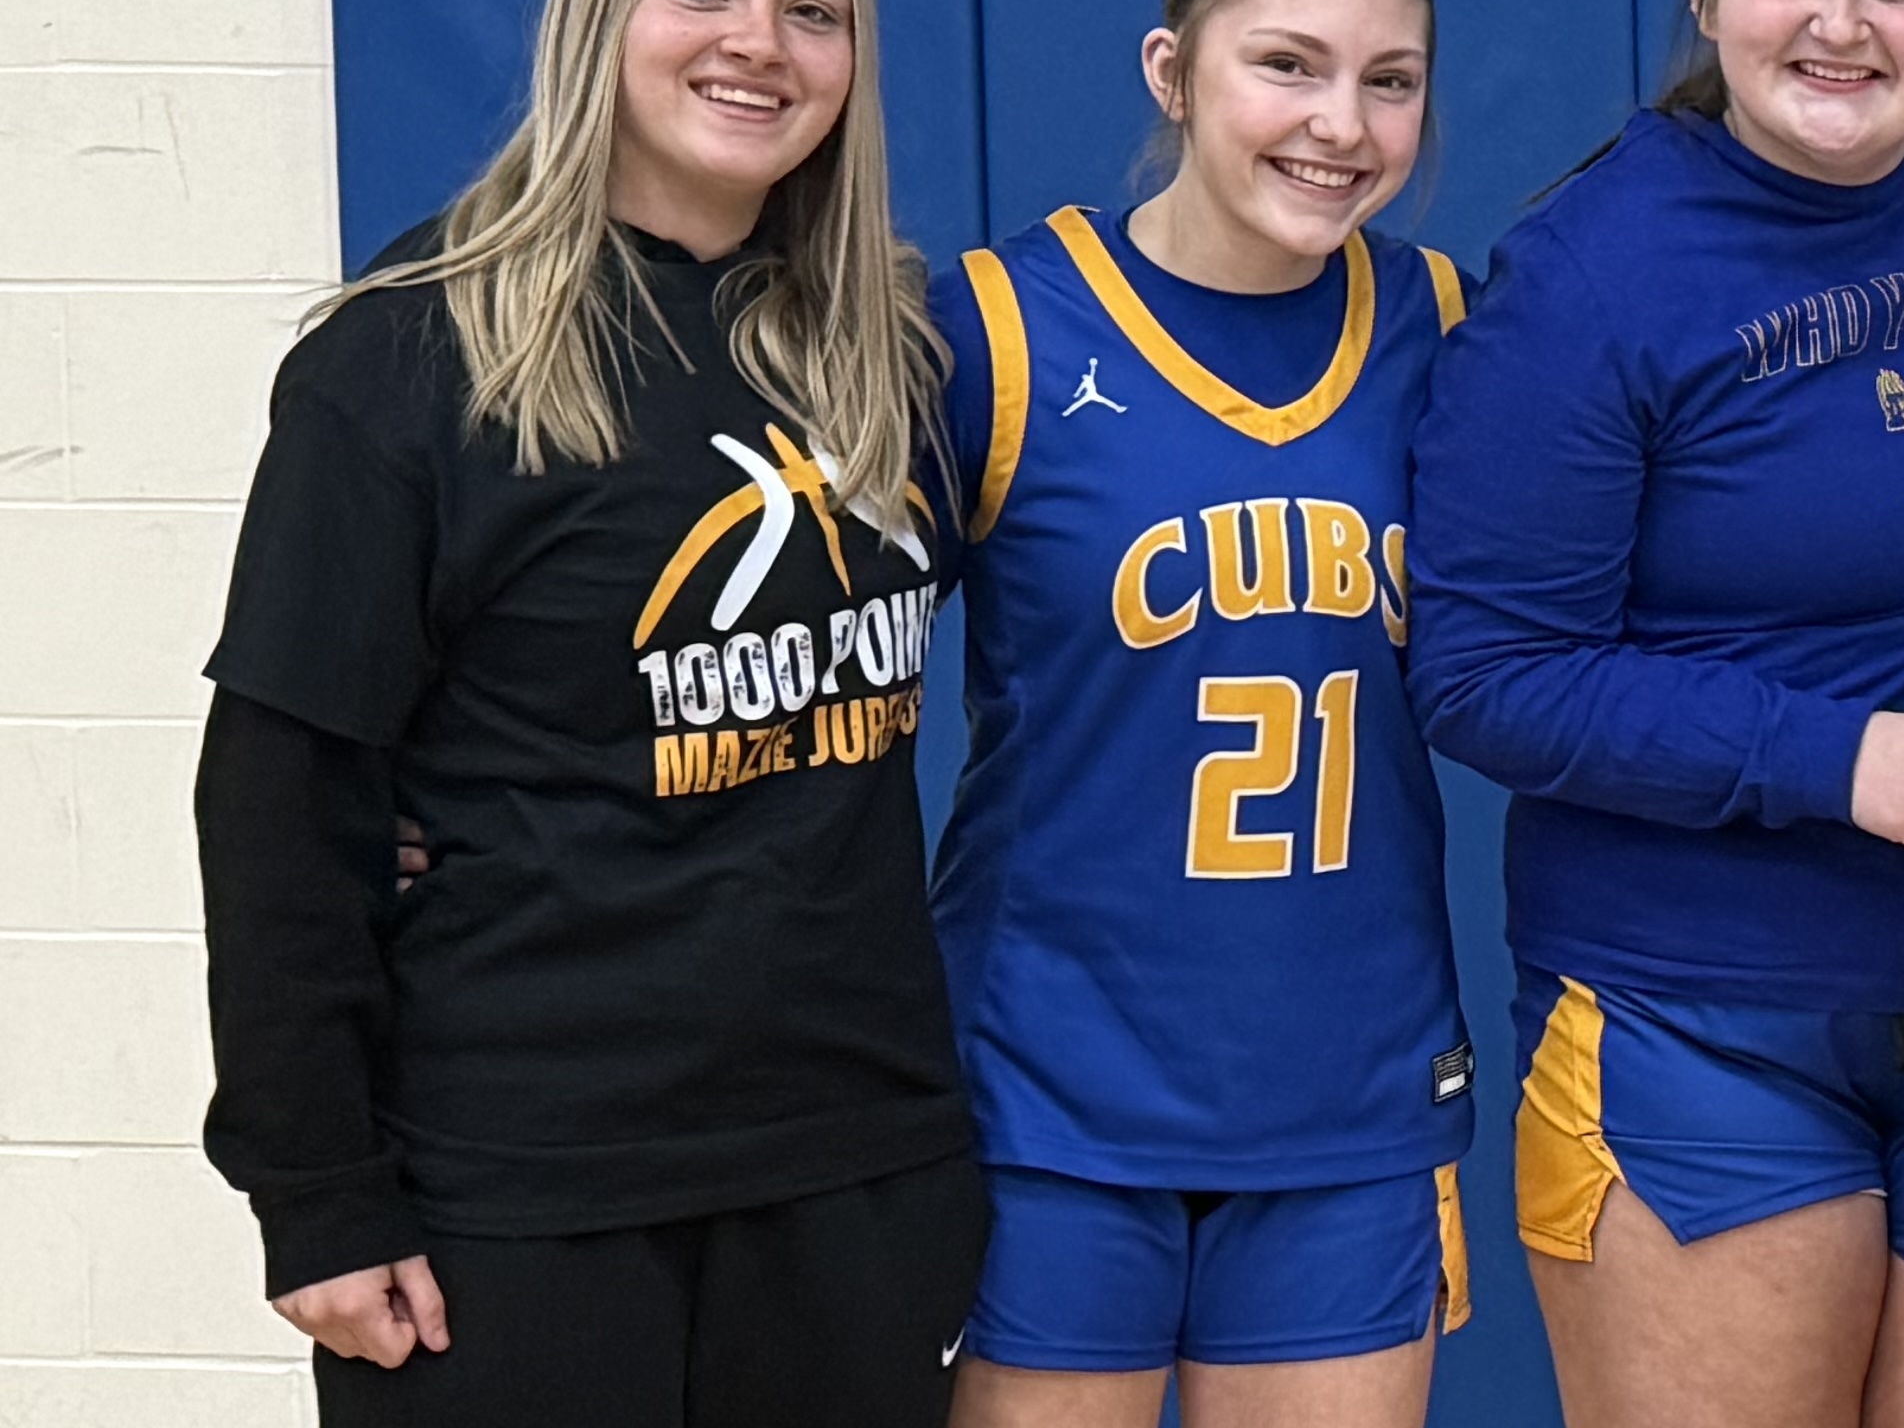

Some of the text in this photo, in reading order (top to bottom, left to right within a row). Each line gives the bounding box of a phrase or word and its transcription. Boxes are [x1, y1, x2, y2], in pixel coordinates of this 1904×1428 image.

[637, 622, 816, 727] 1000
[654, 714, 798, 798] MAZIE
[1184, 667, 1361, 881] 21
